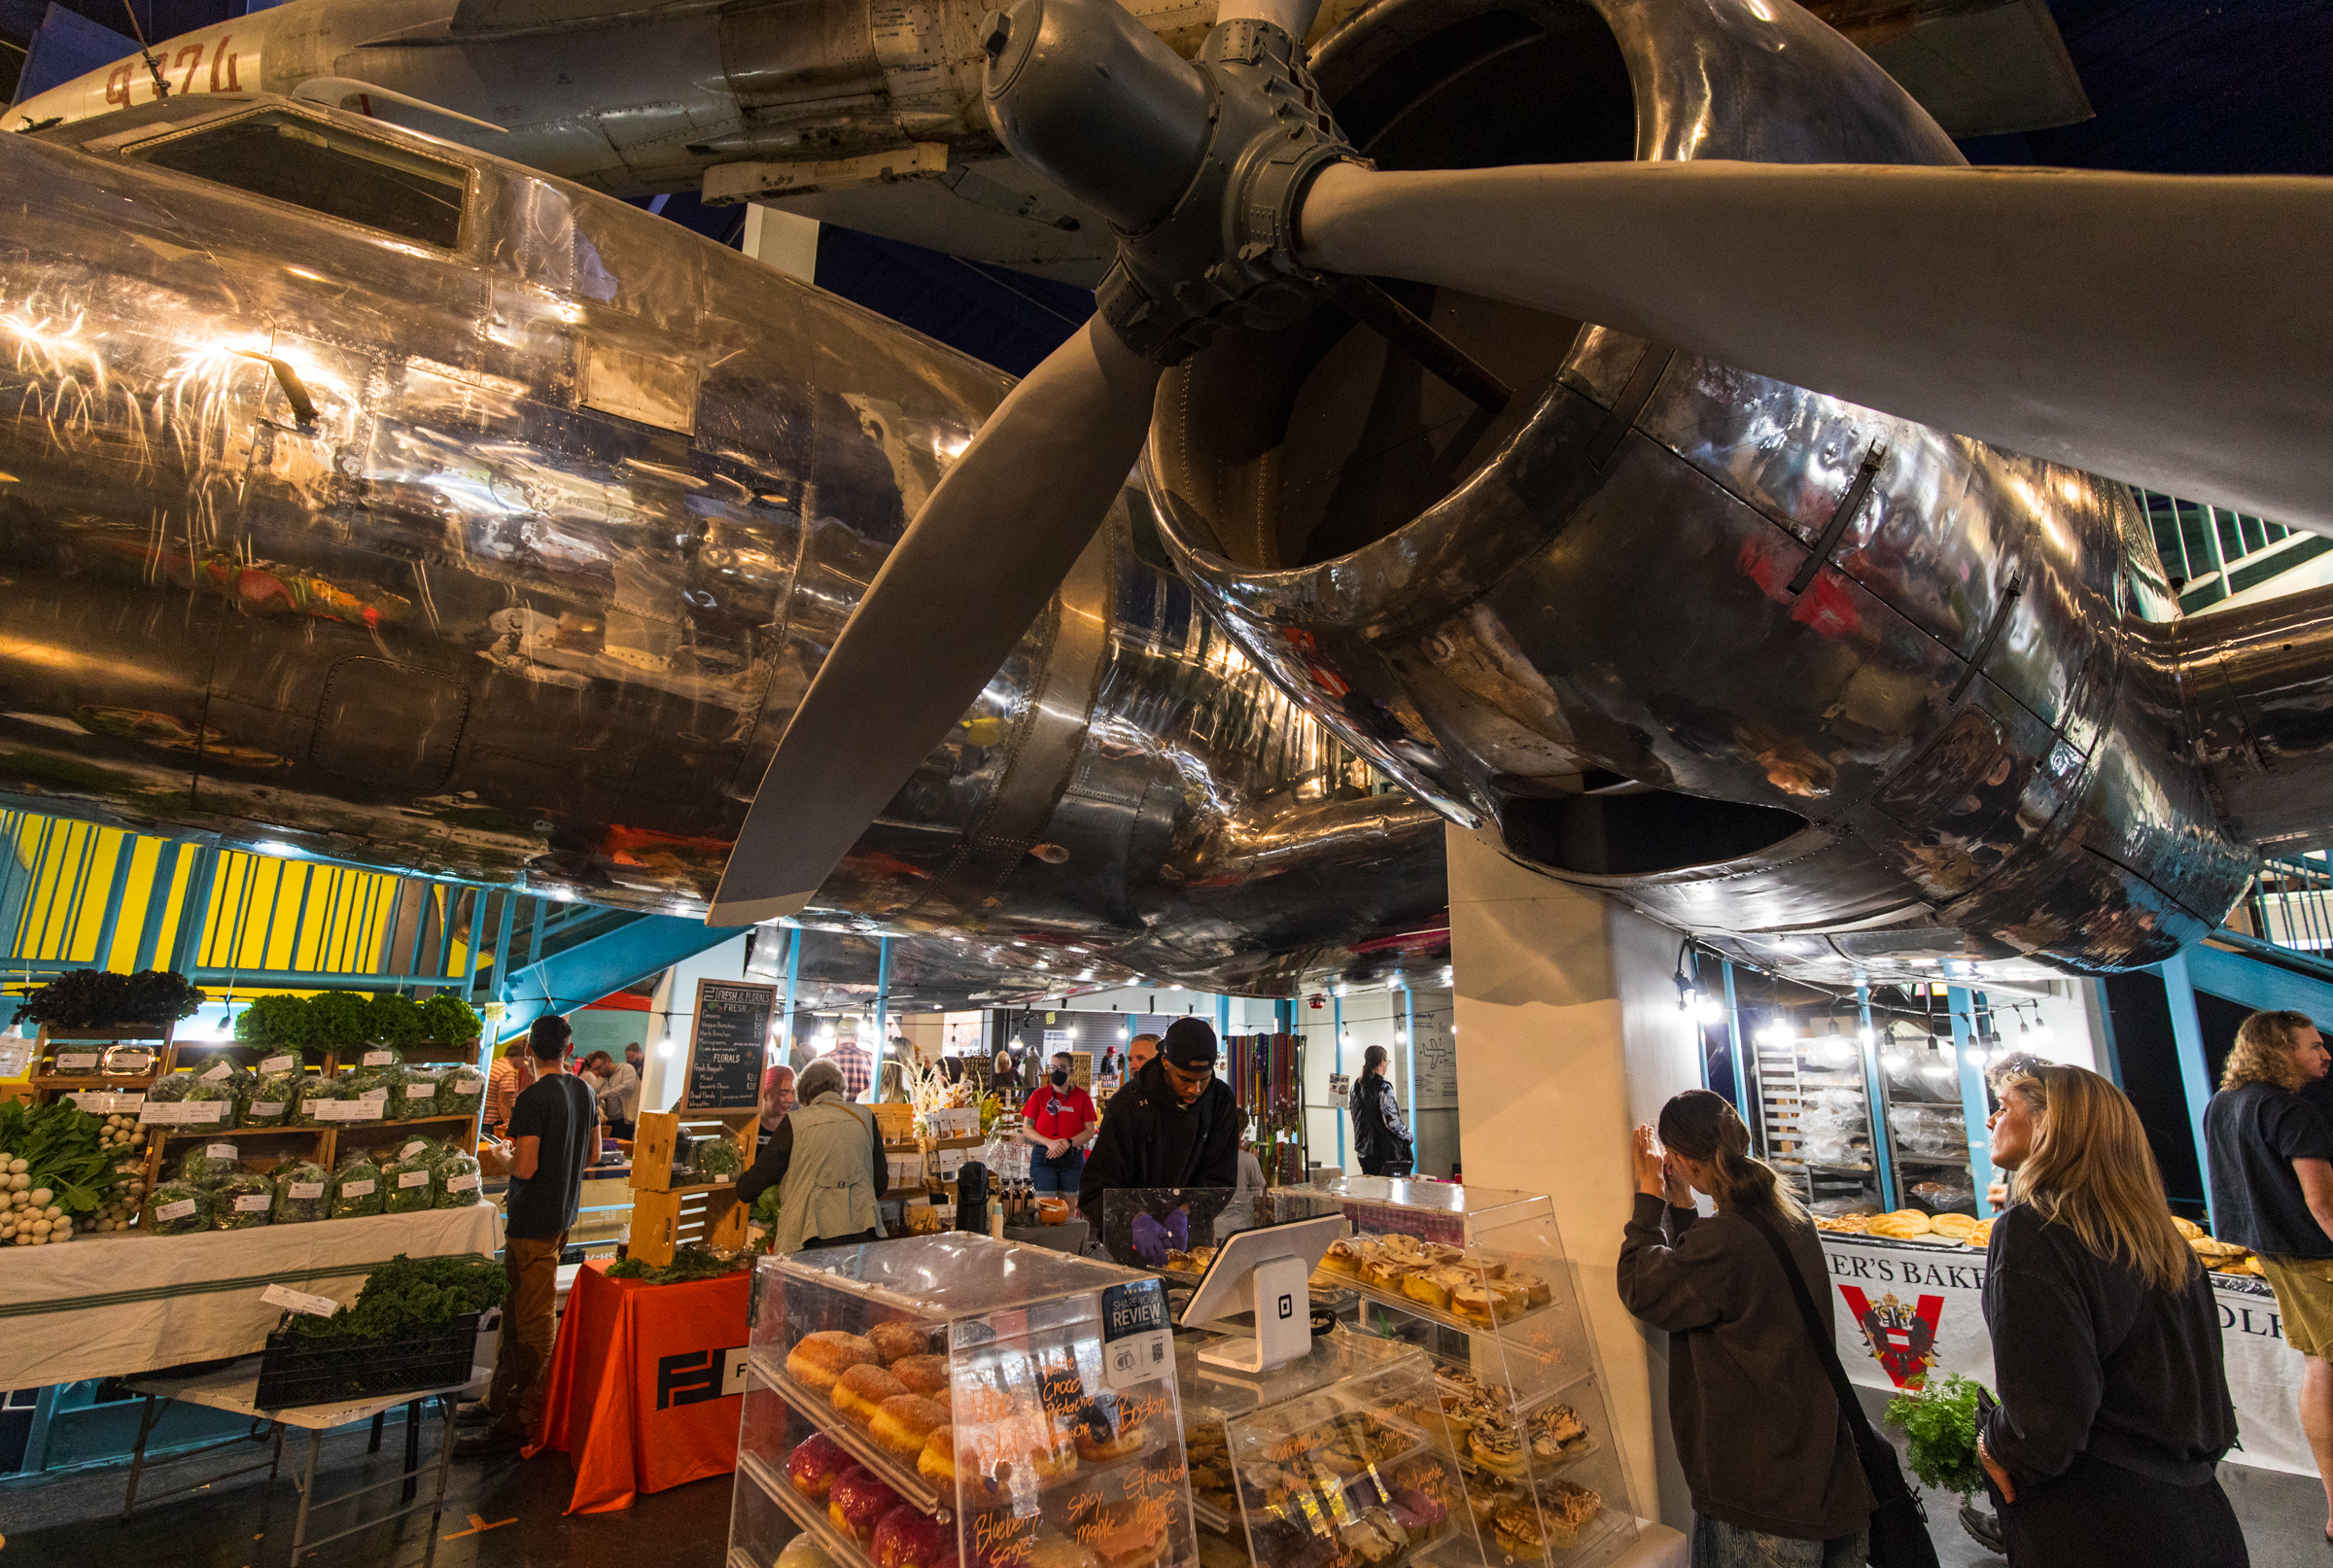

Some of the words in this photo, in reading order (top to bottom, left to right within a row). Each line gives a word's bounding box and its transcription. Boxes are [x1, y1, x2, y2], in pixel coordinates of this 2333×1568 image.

[717, 991, 738, 1001] FRESH
[738, 993, 745, 1001] &
[745, 992, 770, 1003] FLORALS
[723, 1003, 747, 1012] FRESH
[713, 1053, 741, 1063] FLORALS
[1828, 1254, 1894, 1281] ER'S
[1112, 1297, 1137, 1311] SHARE
[1138, 1293, 1160, 1306] YOUR
[1112, 1303, 1161, 1328] REVIEW
[1043, 1377, 1082, 1402] Choco
[1116, 1393, 1167, 1432] Boston
